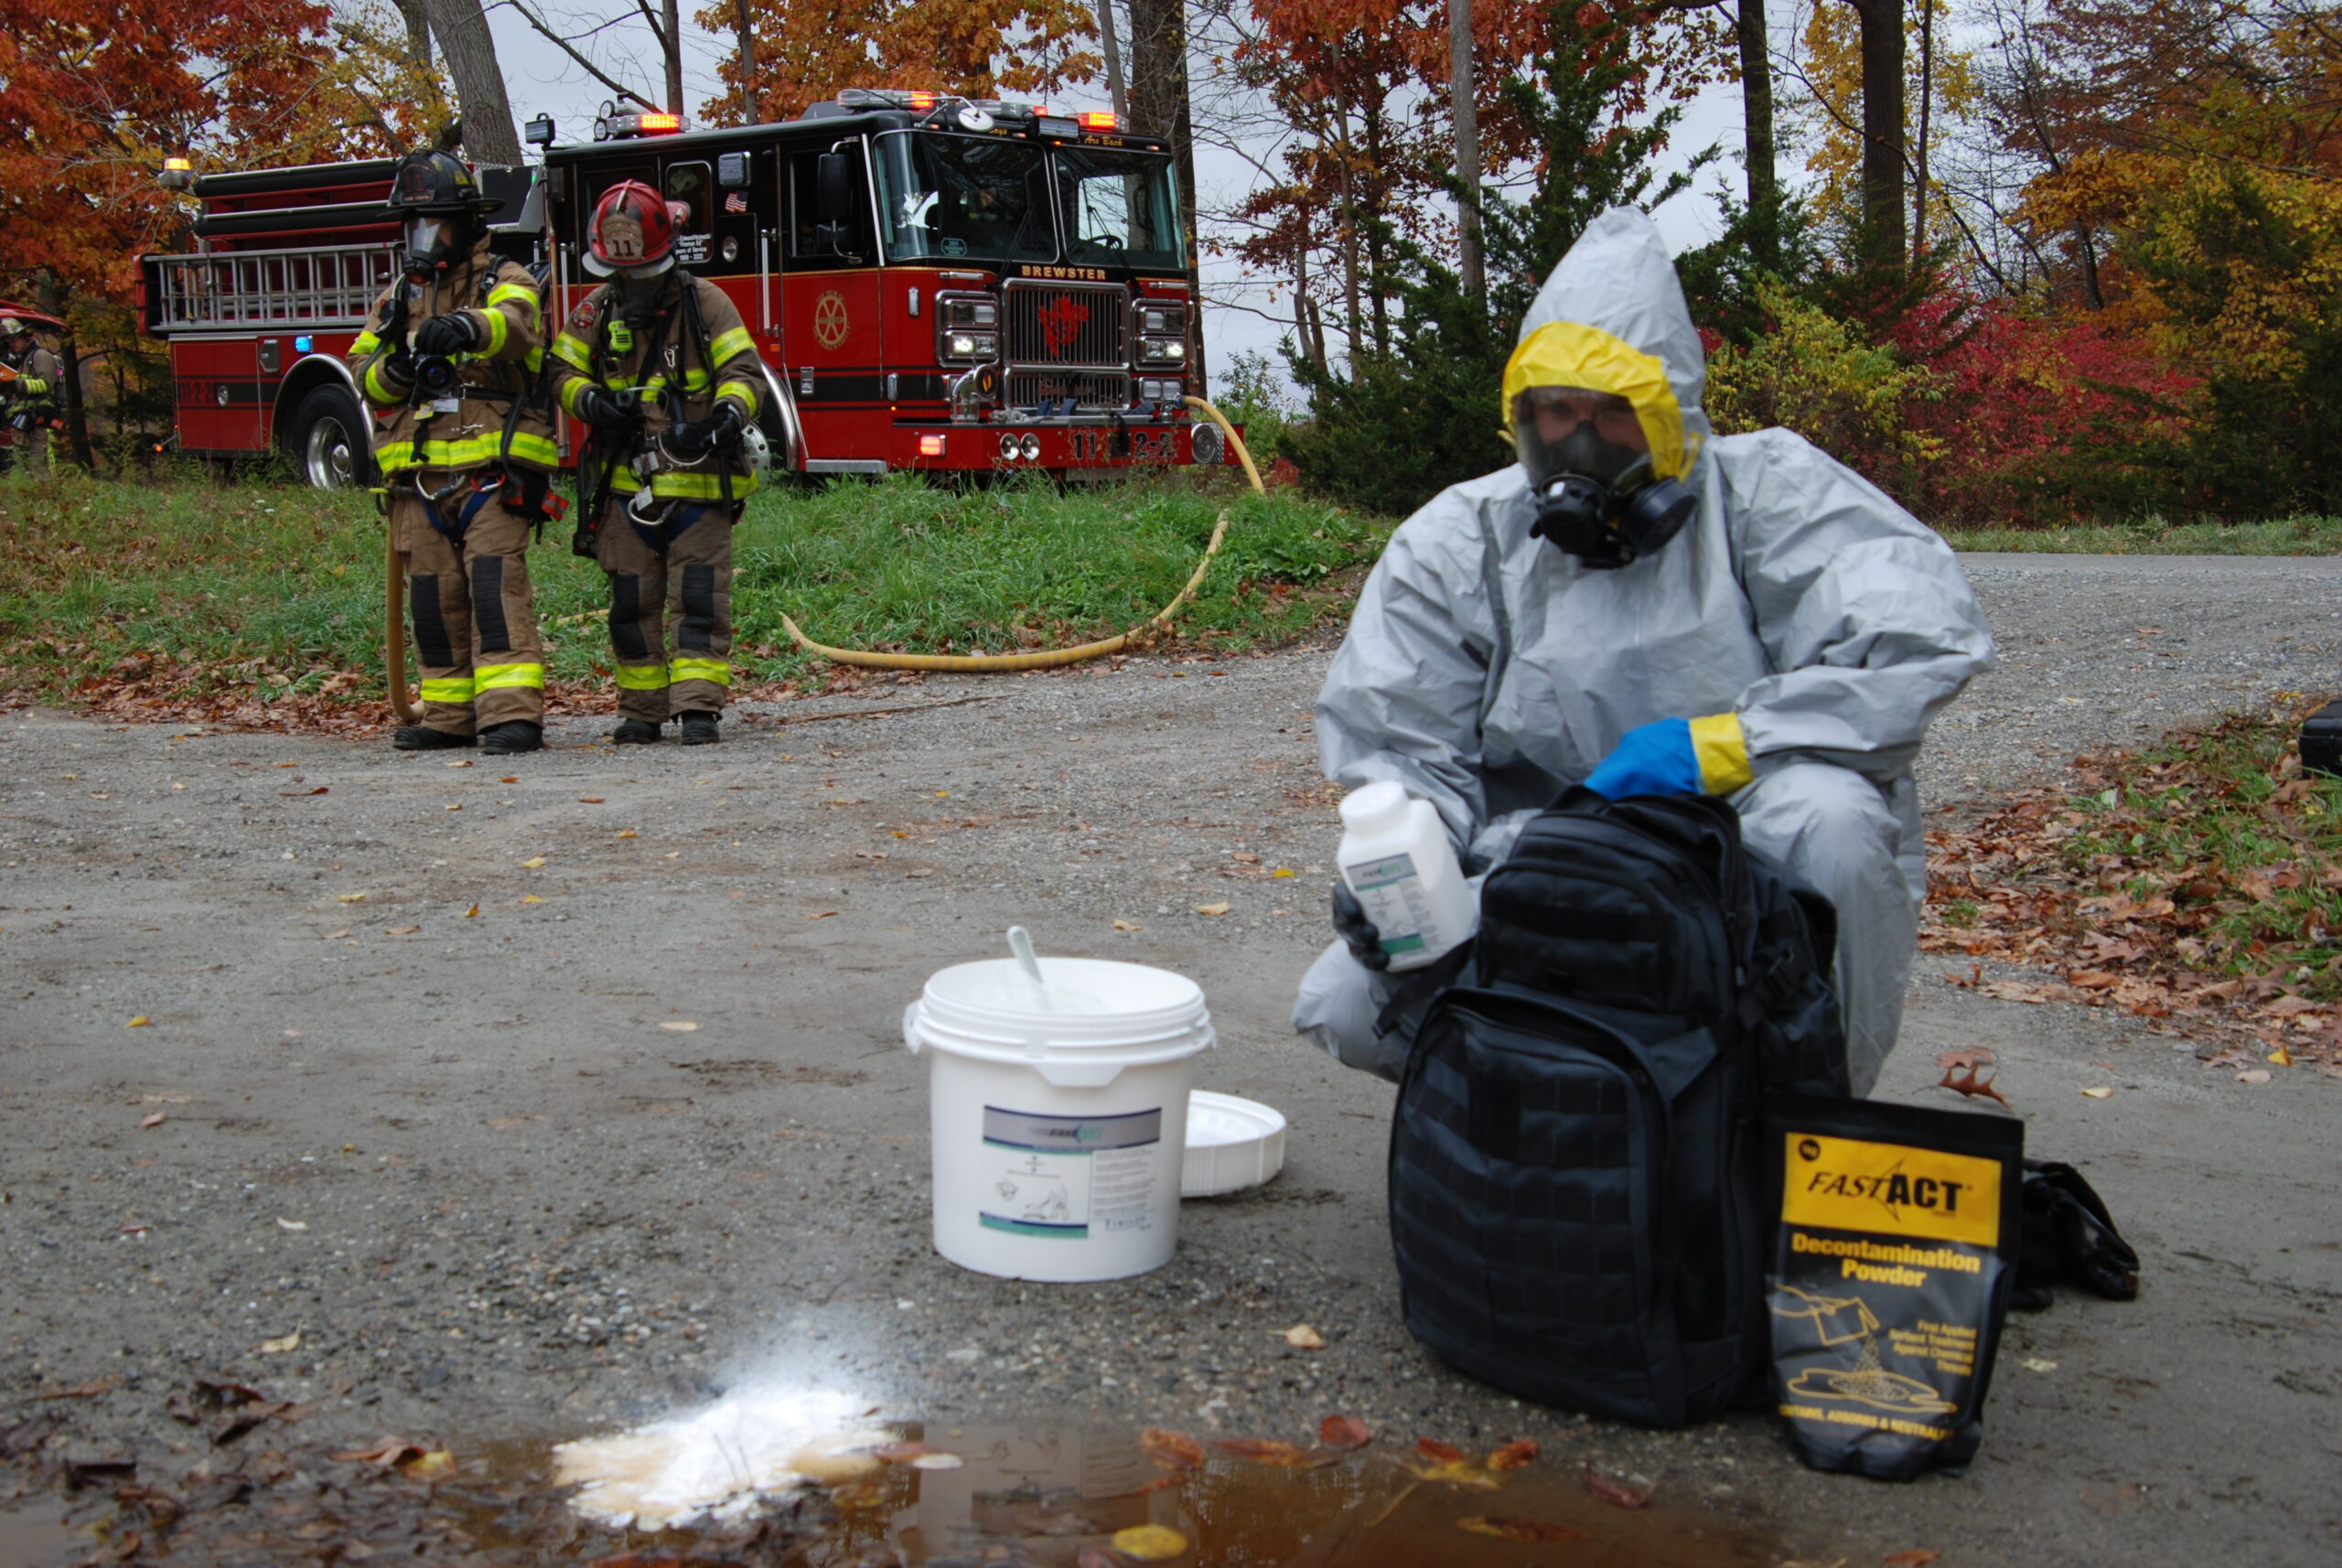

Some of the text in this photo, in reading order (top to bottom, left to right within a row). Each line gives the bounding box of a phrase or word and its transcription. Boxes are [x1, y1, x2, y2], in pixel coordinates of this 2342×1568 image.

[1102, 137, 1123, 146] Back
[612, 240, 635, 256] 11
[1021, 264, 1106, 280] BREWSTER
[1791, 1232, 1981, 1273] Decontamination
[1842, 1259, 1927, 1287] Powder
[1918, 1319, 1977, 1339] First Applied
[1929, 1347, 1974, 1363] Chemical
[1879, 1417, 1889, 1430] &
